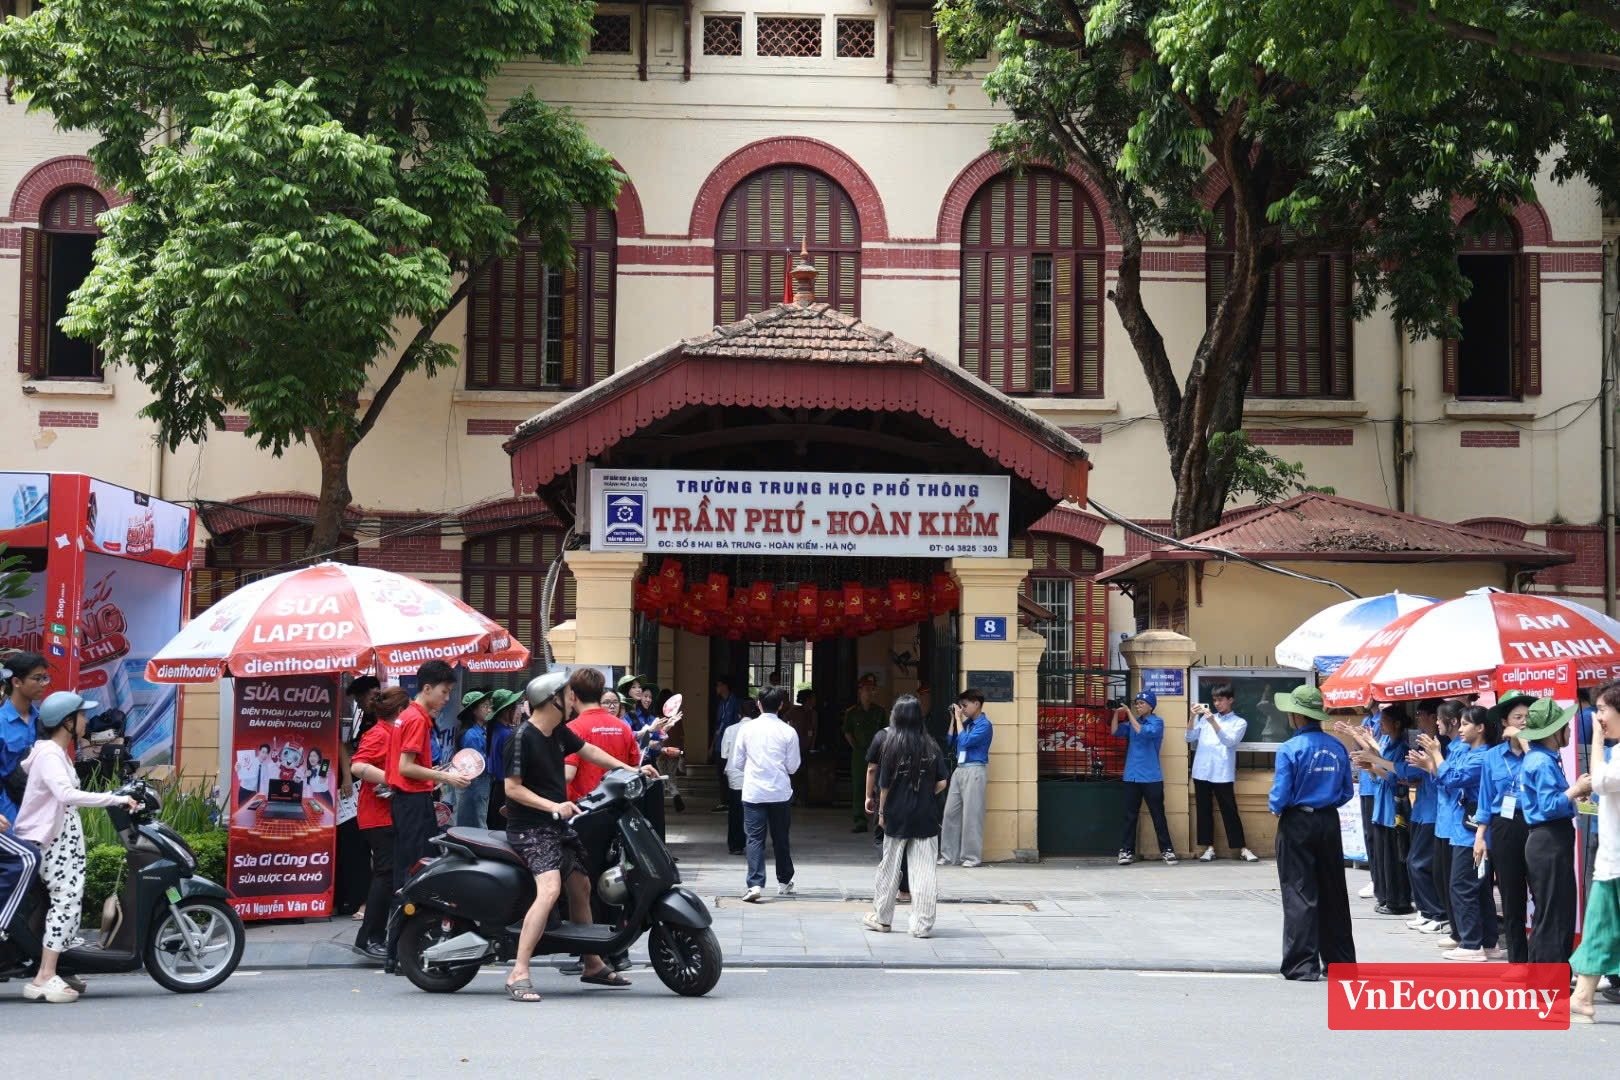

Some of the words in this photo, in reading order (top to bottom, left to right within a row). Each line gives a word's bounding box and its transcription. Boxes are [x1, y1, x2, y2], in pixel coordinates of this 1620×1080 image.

[676, 476, 752, 494] TRƯỜNG
[759, 481, 821, 495] TRUNG
[828, 482, 866, 498] HỌC
[872, 478, 910, 496] PHỔ
[917, 481, 979, 497] THÔNG
[652, 494, 737, 532] TRẦN
[744, 500, 806, 534] PHÚ
[826, 502, 912, 535] HOÀN
[918, 499, 1000, 536] KIẾM
[676, 538, 689, 548] SỐ
[716, 539, 729, 549] BÀ
[731, 541, 762, 549] TRƯNG
[768, 540, 794, 549] HOÀN
[797, 539, 818, 549] KIẾM
[825, 541, 838, 550] HÀ
[840, 542, 856, 552] NỘI
[945, 544, 955, 552] 04
[957, 544, 976, 552] 3825
[56, 598, 66, 619] Shop
[984, 620, 996, 633] 8
[1515, 613, 1570, 630] ÂM
[252, 621, 354, 643] LAPTOP
[389, 642, 479, 664] dienthoaivui
[1508, 638, 1614, 659] THANH
[244, 654, 357, 674] dienthoaivui
[467, 658, 524, 670] dienthoaivui
[243, 681, 280, 702] SỬA
[283, 685, 330, 704] CHỮA
[288, 709, 319, 718] LAPTOP
[249, 717, 266, 727] BÁN
[266, 718, 286, 728] ĐIỆN
[233, 853, 257, 868] Sửa
[259, 853, 272, 866] Gì
[273, 853, 308, 868] Cũng
[309, 851, 330, 865] Có
[238, 872, 255, 884] SỬA
[257, 873, 283, 884] ĐƯỢC
[283, 873, 297, 882] CA
[298, 871, 323, 882] KHÓ
[234, 903, 251, 915] 274
[253, 900, 284, 915] Nguyễn
[287, 900, 308, 912] Văn
[311, 899, 326, 911] Cừ
